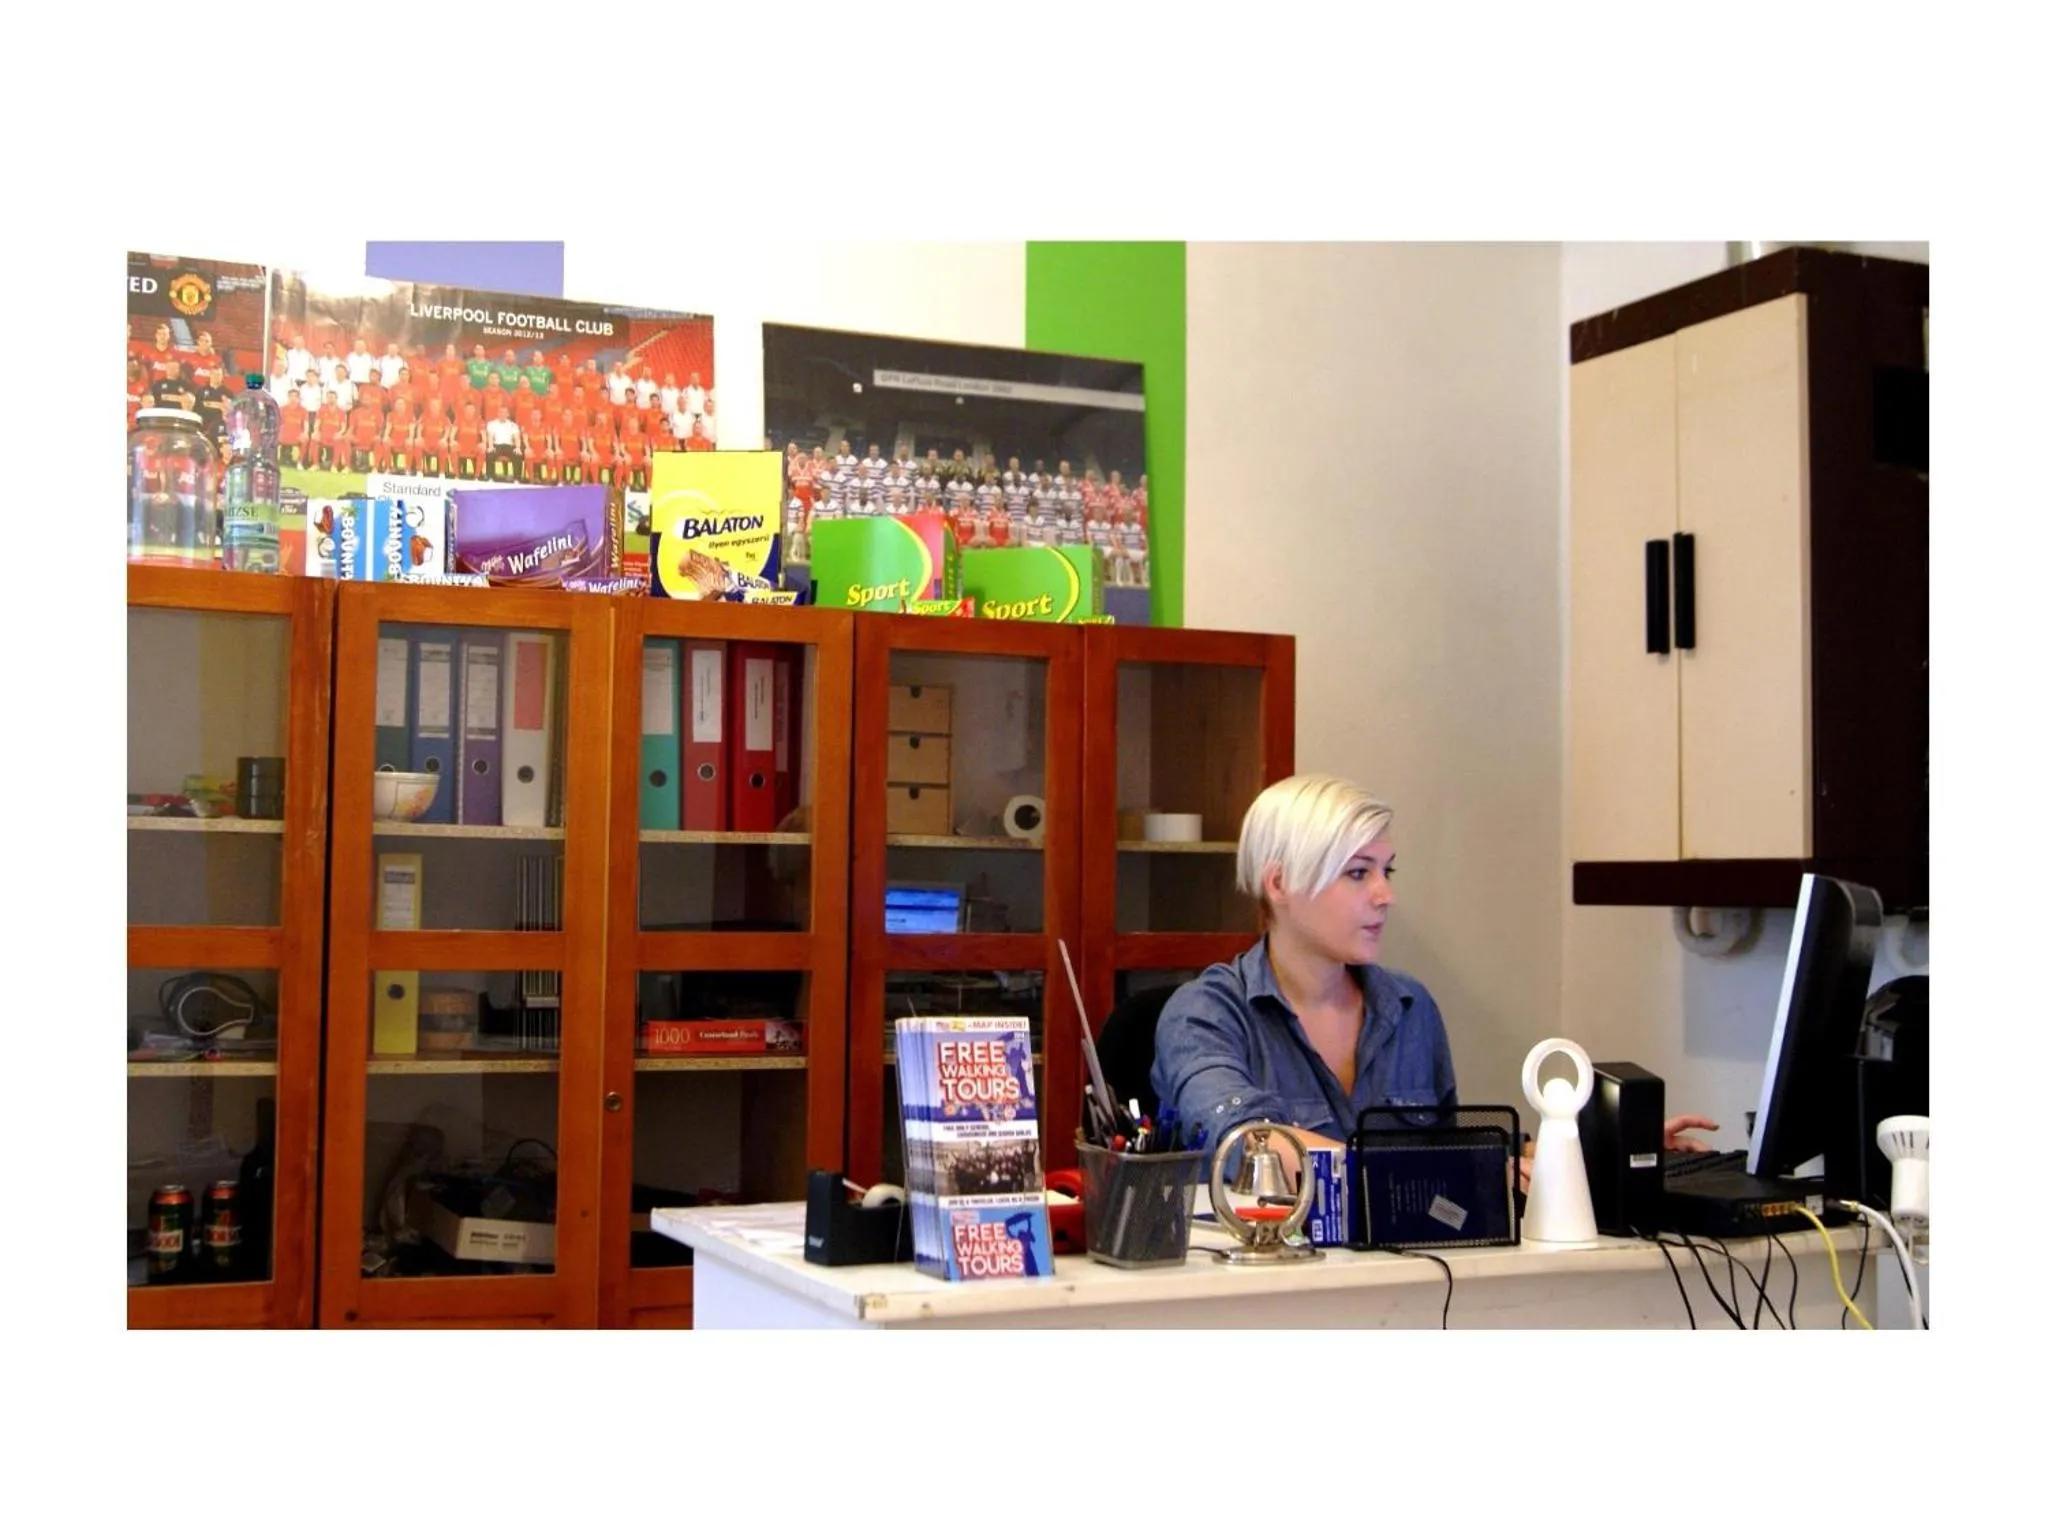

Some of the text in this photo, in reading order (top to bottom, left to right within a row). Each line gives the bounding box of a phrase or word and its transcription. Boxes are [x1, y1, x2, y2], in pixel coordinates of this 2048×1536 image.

[127, 276, 158, 294] ED
[410, 303, 614, 336] LIVERPOOL FOOTBALL CLUB
[482, 326, 512, 336] SEASON
[383, 481, 441, 497] Standard
[682, 515, 764, 540] BALATON
[388, 504, 404, 575] BOUNTY
[507, 533, 573, 575] Wafelini
[847, 577, 911, 607] Sport
[982, 594, 1052, 620] Sport
[654, 1027, 691, 1045] 1000
[939, 1040, 1005, 1063] FREE
[941, 1063, 1007, 1078] WALKING
[942, 1077, 1020, 1100] TOURS
[954, 1222, 1006, 1242] FREE
[956, 1240, 1022, 1257] WALKING
[958, 1255, 1024, 1275] TOURS
